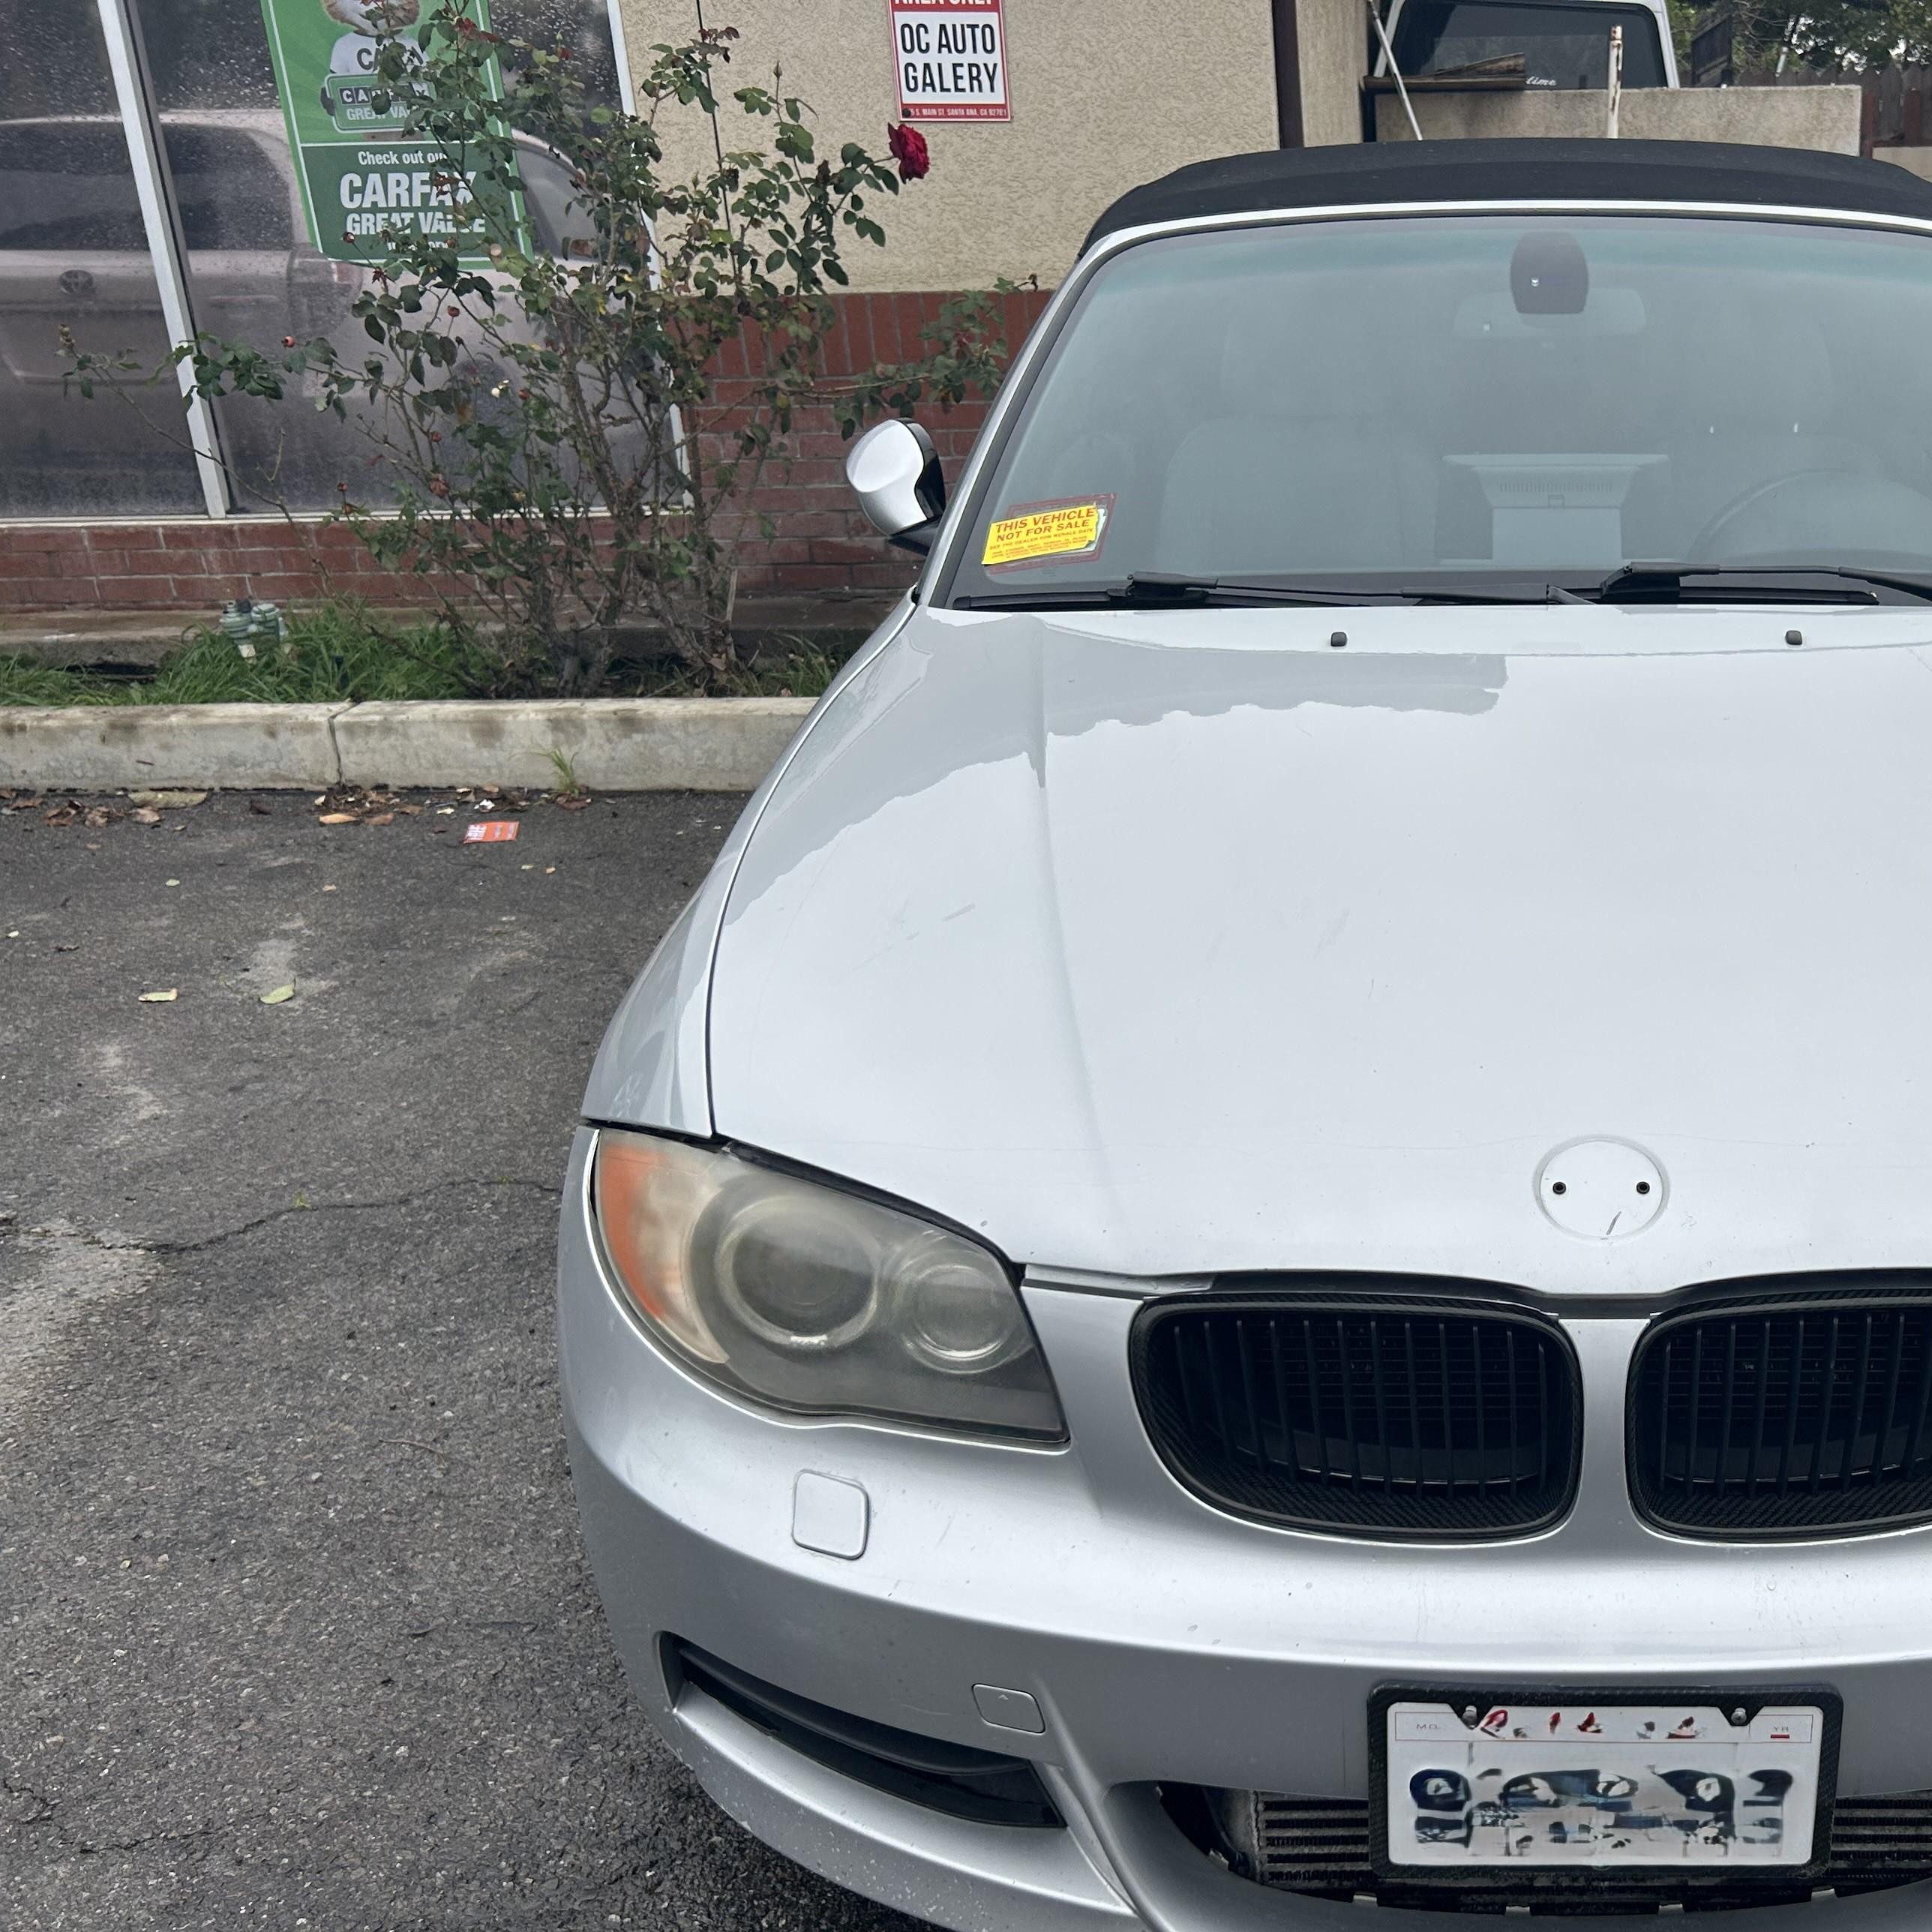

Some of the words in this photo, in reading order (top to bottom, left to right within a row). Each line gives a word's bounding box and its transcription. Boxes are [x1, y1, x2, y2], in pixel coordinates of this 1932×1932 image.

[900, 23, 930, 54] OC
[938, 23, 996, 54] AUTO
[904, 62, 998, 93] GALERY
[346, 107, 386, 120] GRE
[358, 152, 399, 165] Check
[402, 151, 424, 164] out
[340, 171, 477, 208] CARFAX
[418, 212, 486, 234] VALE
[996, 518, 1028, 533] THIS
[1033, 508, 1096, 526] VEHICLE
[996, 530, 1021, 542] NOT
[1025, 526, 1052, 536] FOR
[1056, 519, 1090, 531] SALE
